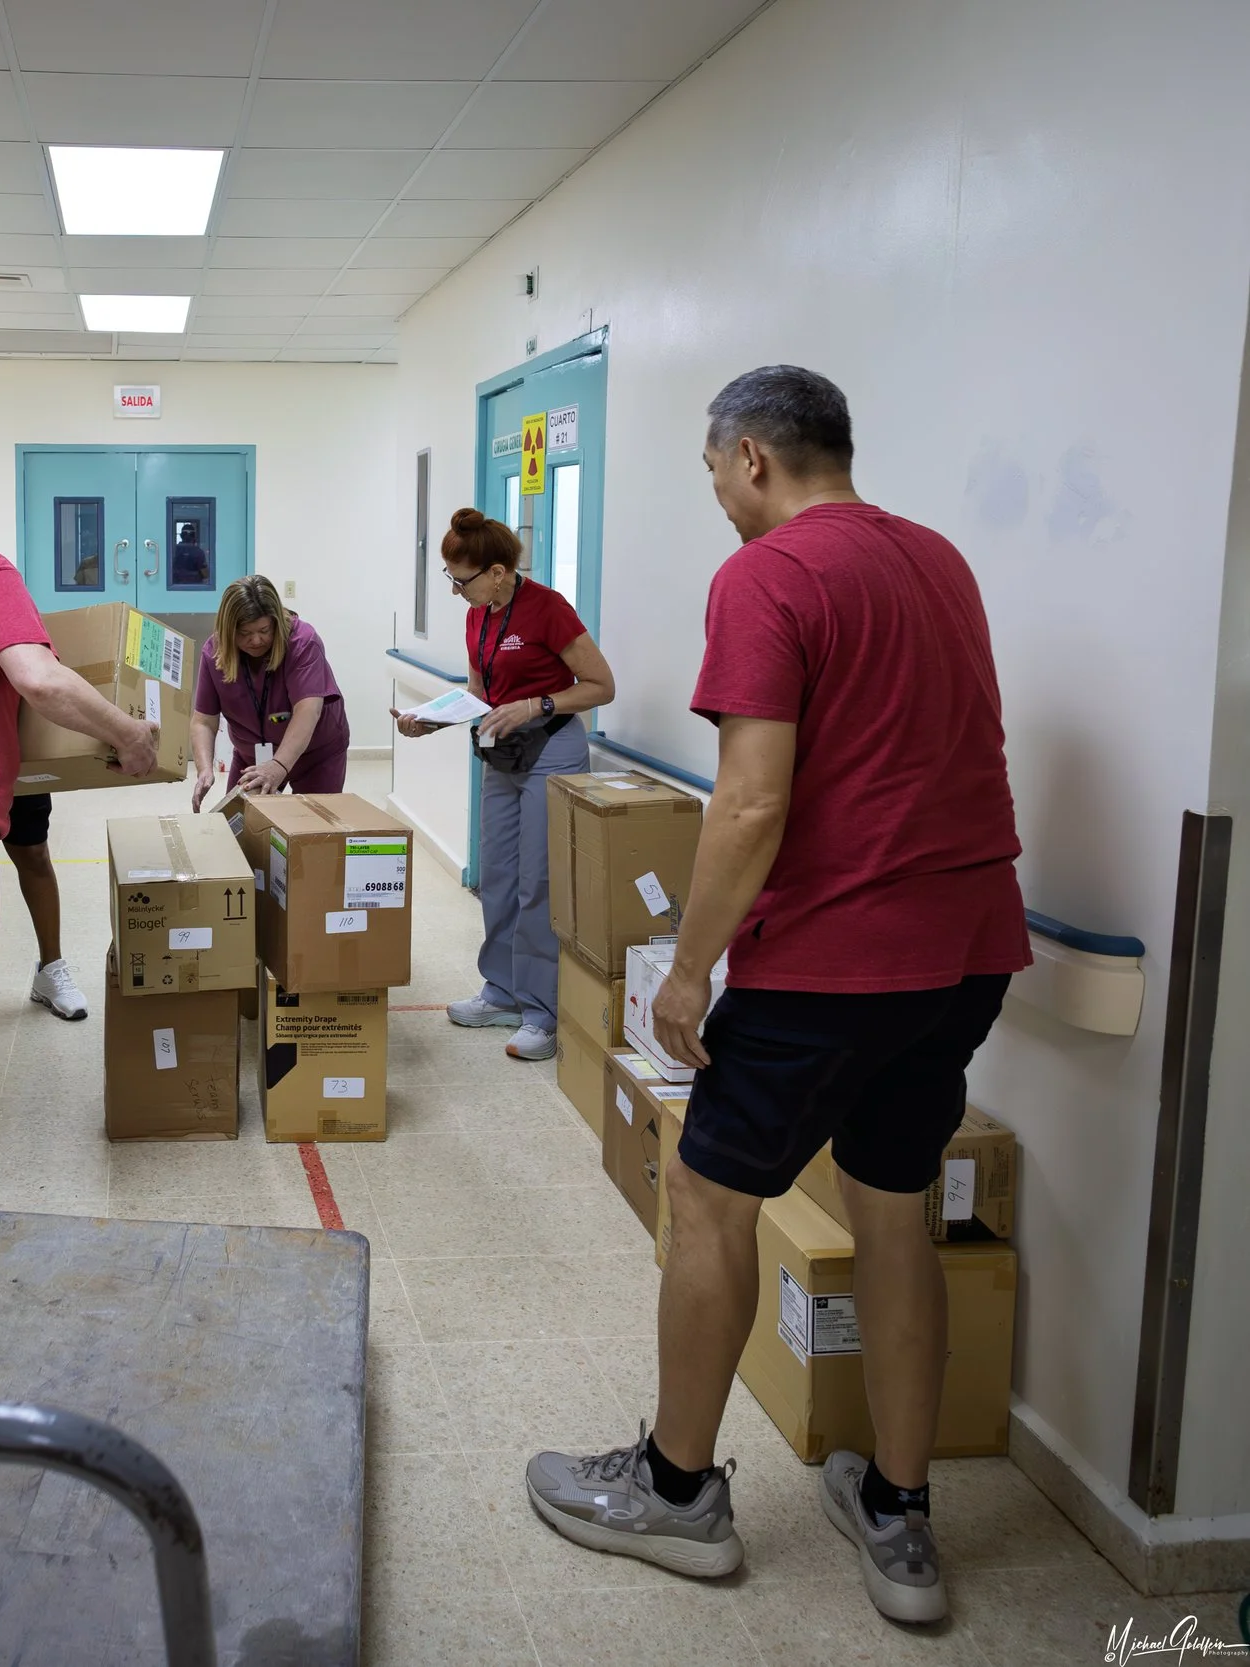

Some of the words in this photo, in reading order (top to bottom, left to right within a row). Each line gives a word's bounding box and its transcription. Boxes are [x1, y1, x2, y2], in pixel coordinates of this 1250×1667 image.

[121, 396, 153, 407] SALIDA
[550, 411, 576, 428] CUARTO
[365, 882, 404, 891] 6908868
[128, 916, 166, 931] Biogel
[339, 916, 354, 927] 110
[178, 931, 191, 943] 99
[275, 1015, 313, 1024] Extremity
[314, 1015, 337, 1024] Drape
[275, 1024, 302, 1032] Champ
[330, 1079, 349, 1093] 73
[947, 1176, 967, 1202] 94
